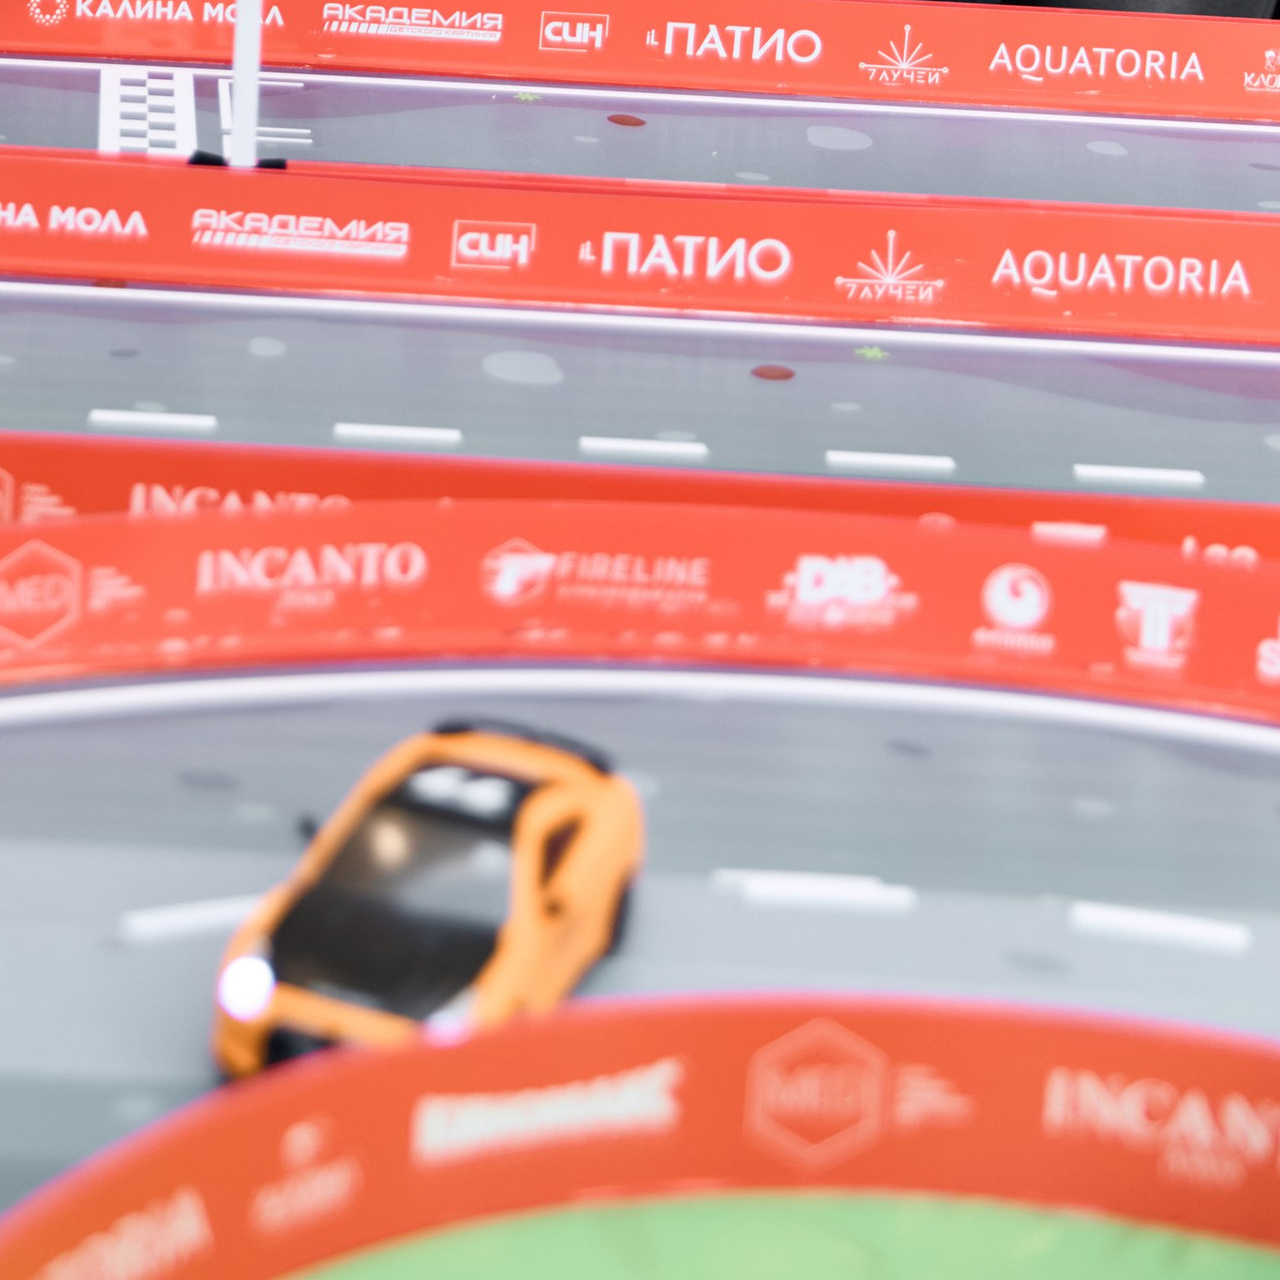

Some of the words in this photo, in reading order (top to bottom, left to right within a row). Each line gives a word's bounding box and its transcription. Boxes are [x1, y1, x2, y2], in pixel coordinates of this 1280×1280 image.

[322, 2, 504, 30] АКАДЕМИЯ
[664, 21, 822, 64] ПАТИО
[988, 42, 1205, 82] AQUATORIA
[48, 205, 149, 237] МОЛЛ
[192, 208, 410, 243] АКАДЕМИЯ
[600, 231, 792, 282] ПАТИО
[991, 248, 1251, 298] AQUATORIA
[195, 542, 428, 595] INCANTO
[555, 551, 710, 587] FIRELINE
